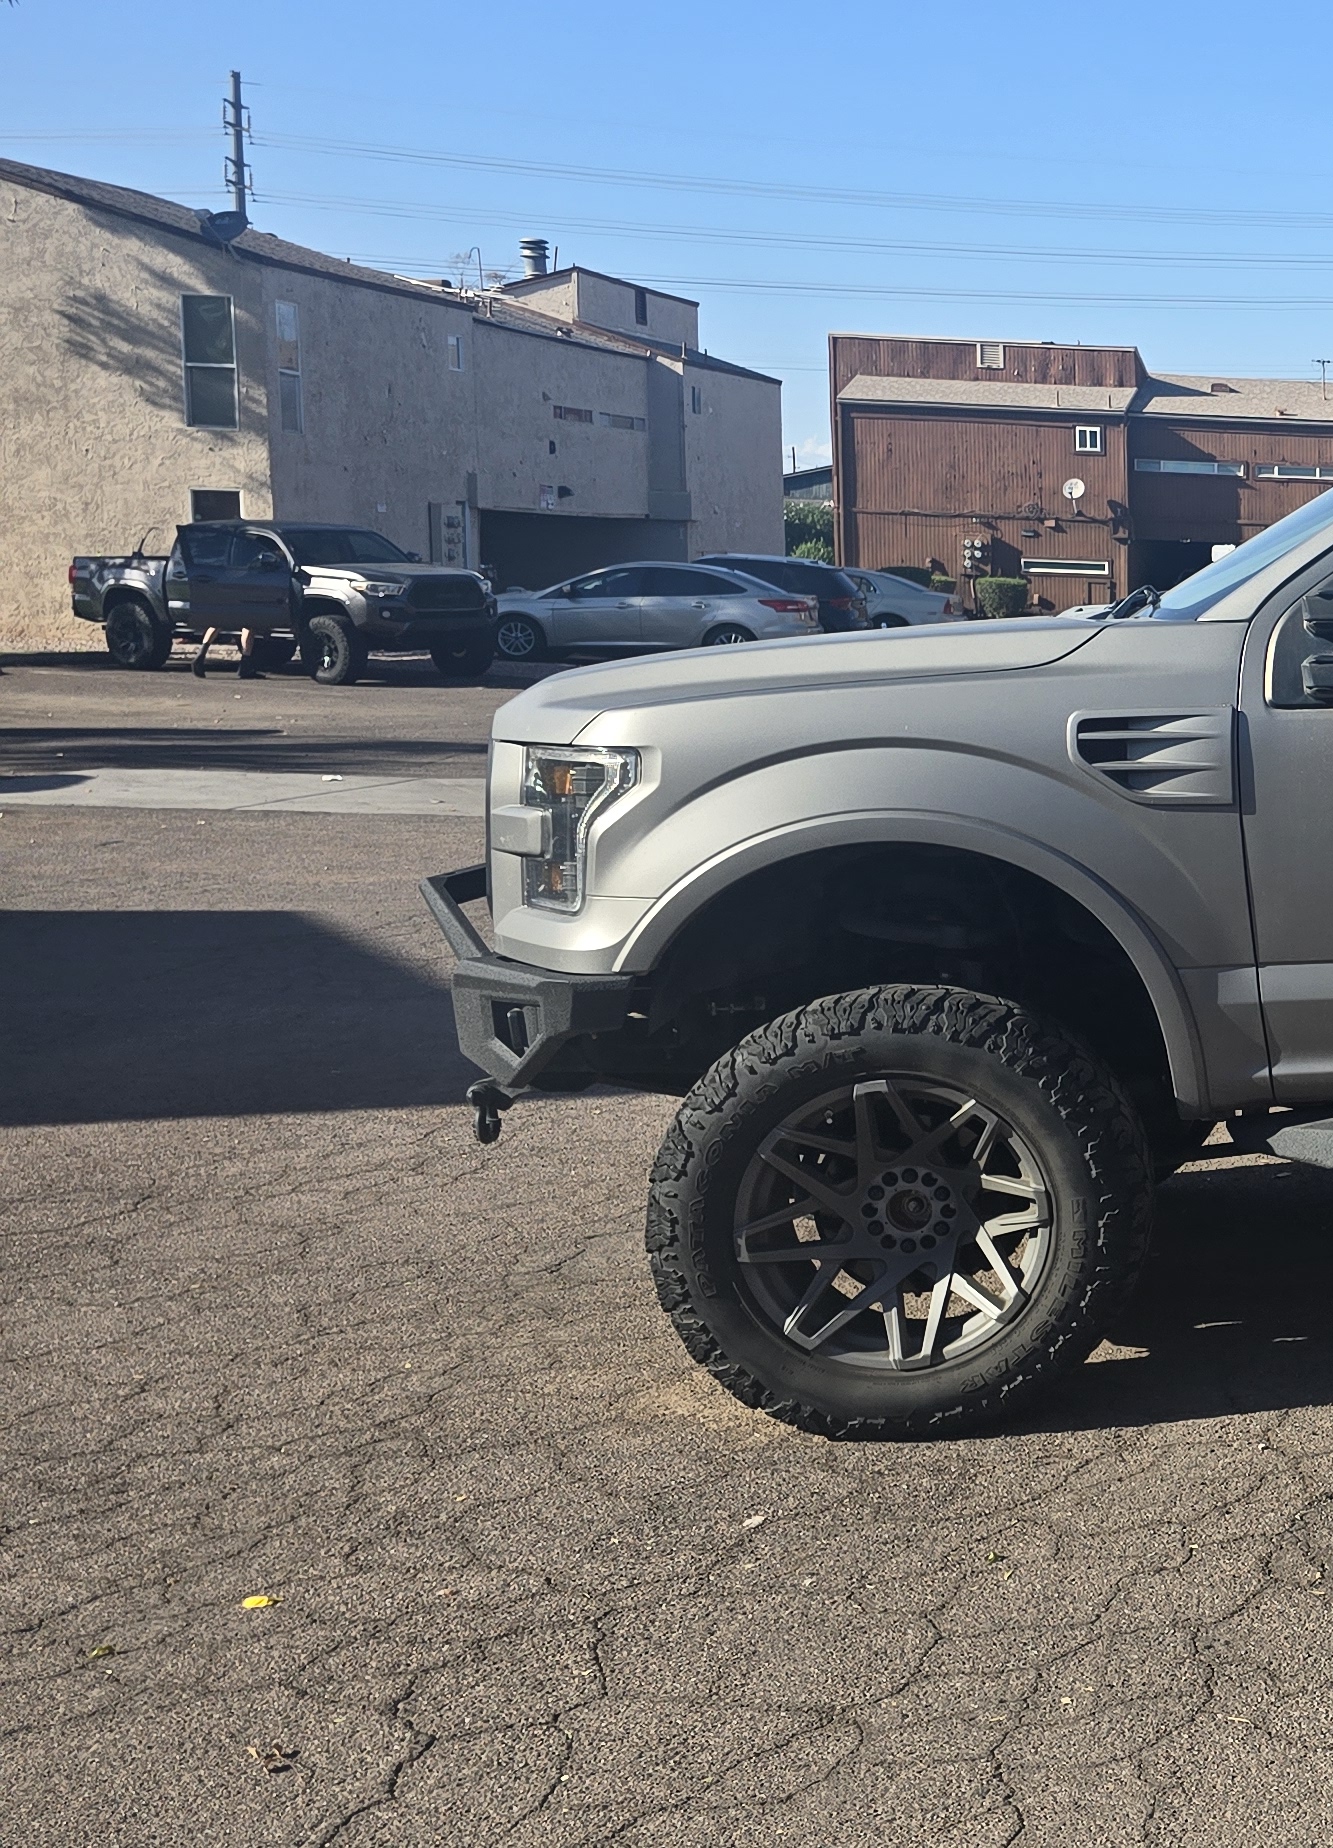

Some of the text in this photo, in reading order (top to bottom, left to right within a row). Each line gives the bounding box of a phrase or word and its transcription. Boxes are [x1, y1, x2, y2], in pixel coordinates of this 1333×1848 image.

[689, 1046, 867, 1298] PATAGONIA M/T
[960, 1229, 1087, 1394] MILESTAR
